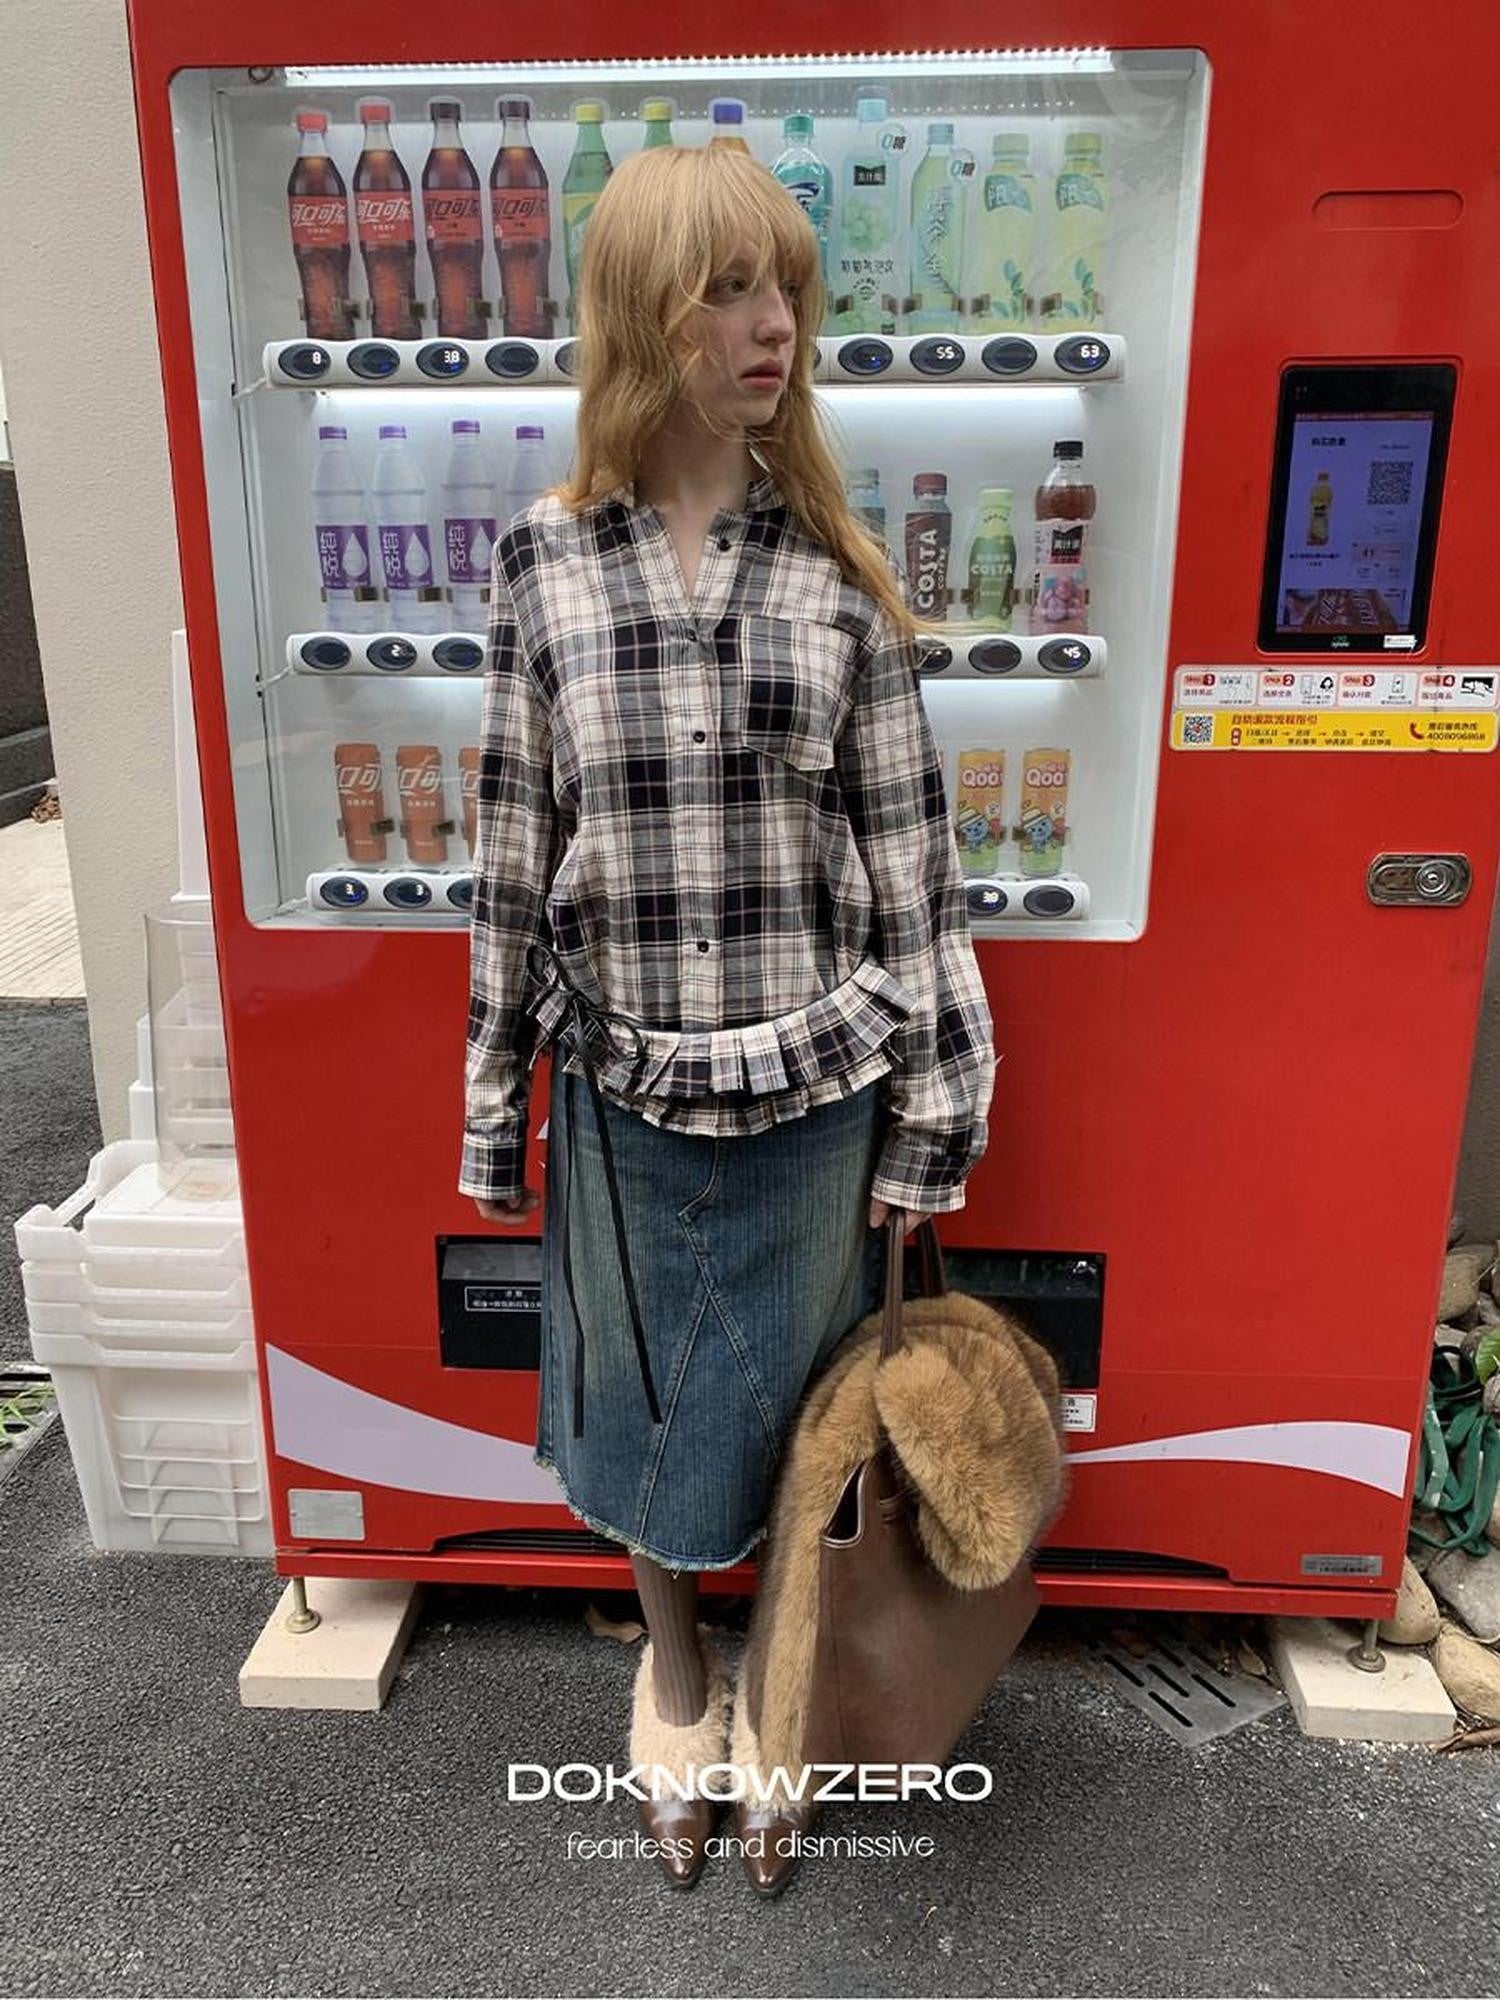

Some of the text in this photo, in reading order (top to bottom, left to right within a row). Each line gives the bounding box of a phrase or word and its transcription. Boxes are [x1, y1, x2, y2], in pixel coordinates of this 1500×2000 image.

[917, 529, 938, 609] COSTA
[970, 563, 1013, 576] COSTA
[962, 769, 1000, 787] Qoo
[1026, 768, 1065, 787] Qoo
